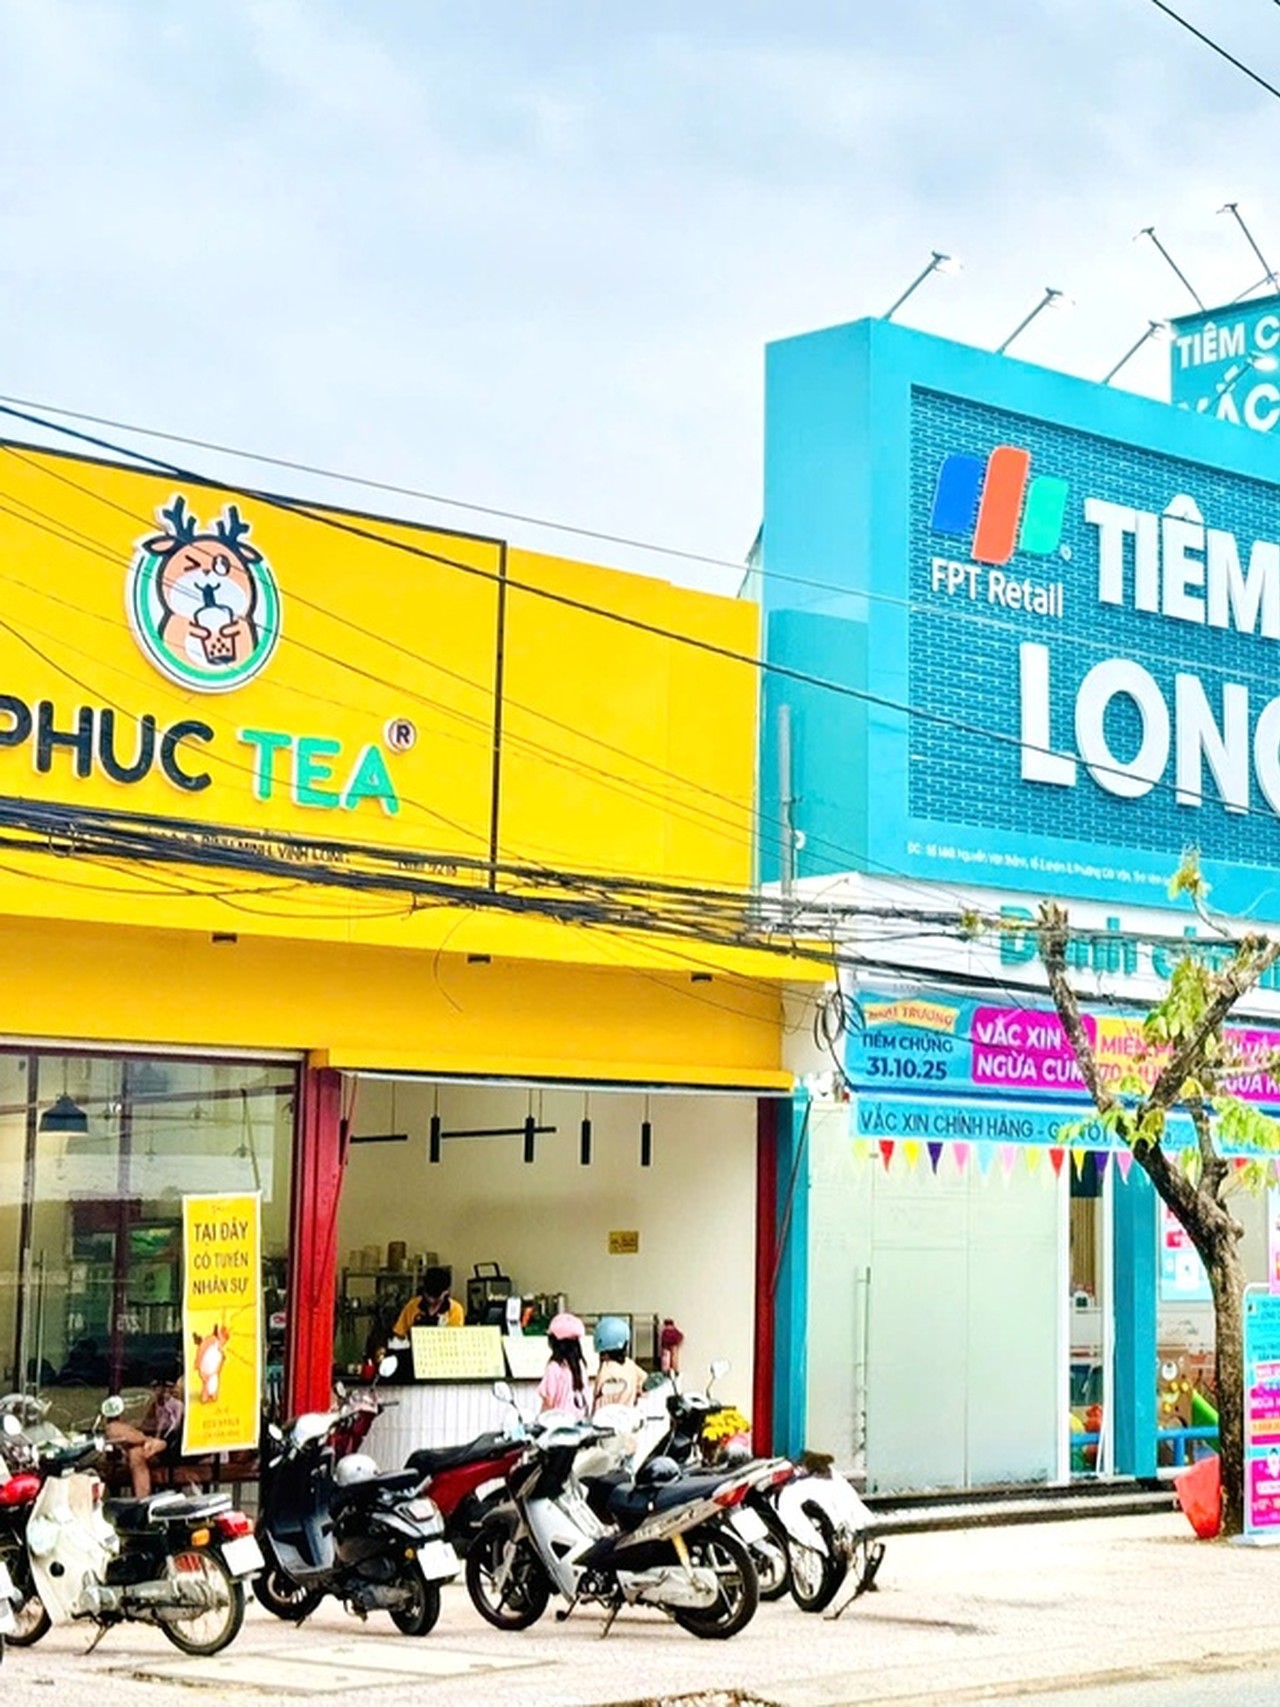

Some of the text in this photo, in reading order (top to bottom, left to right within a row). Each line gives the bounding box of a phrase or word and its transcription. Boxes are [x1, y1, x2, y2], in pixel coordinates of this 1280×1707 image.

[1176, 321, 1245, 369] TIÊM
[1178, 365, 1280, 431] ẮC
[931, 557, 1063, 619] FPT Retail
[239, 727, 400, 816] TEA
[1000, 905, 1138, 975] Dnh
[976, 1017, 1061, 1050] VẮC XIN
[866, 1056, 947, 1080] 31.10.25
[977, 1050, 1037, 1080] NGỪA
[861, 1103, 897, 1131] VẮC
[902, 1114, 929, 1132] XIN
[934, 1109, 982, 1135] CHÍNH
